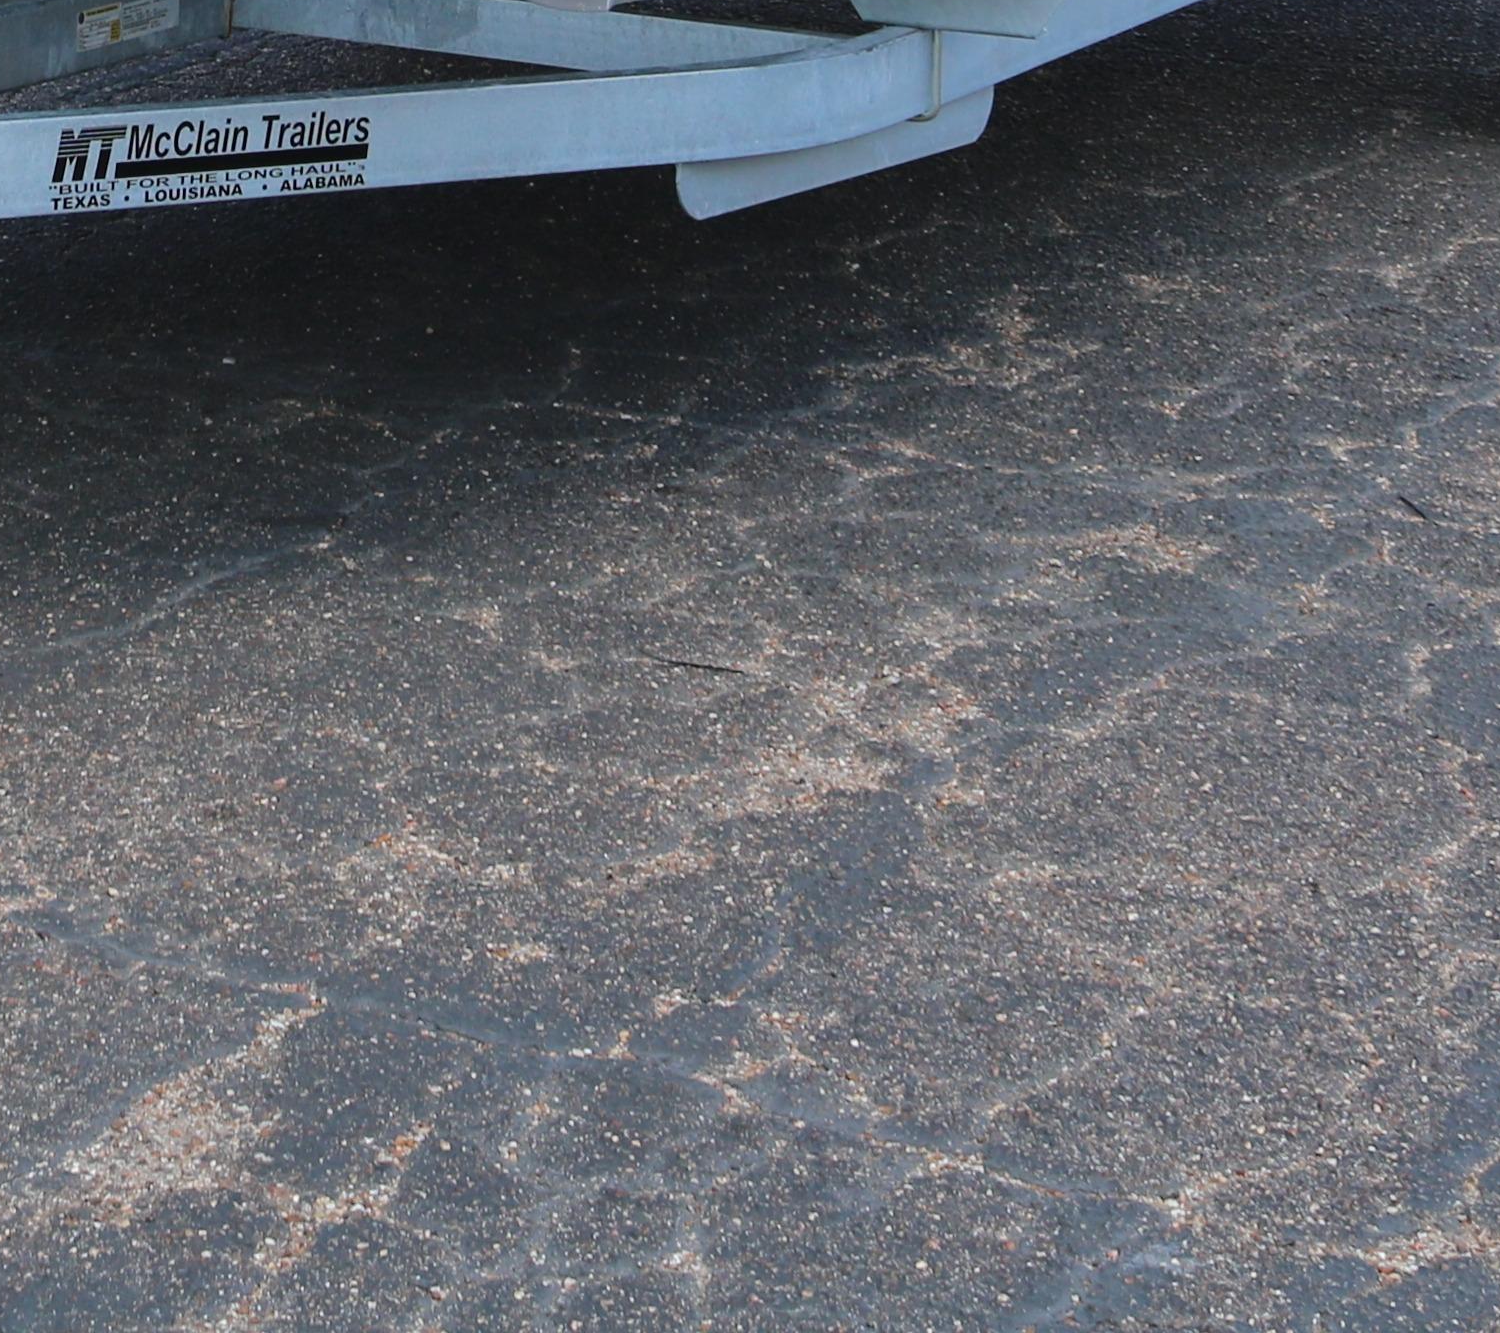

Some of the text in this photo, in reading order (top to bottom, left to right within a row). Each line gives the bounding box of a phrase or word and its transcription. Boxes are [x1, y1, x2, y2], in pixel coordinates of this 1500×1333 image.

[126, 117, 249, 161] McClain
[261, 111, 370, 150] Trailers
[51, 171, 366, 211] TEXAS LOUISIANA ALABAMA
[126, 176, 170, 190] FOR
[181, 172, 218, 186] THE
[224, 166, 284, 182] LONG
